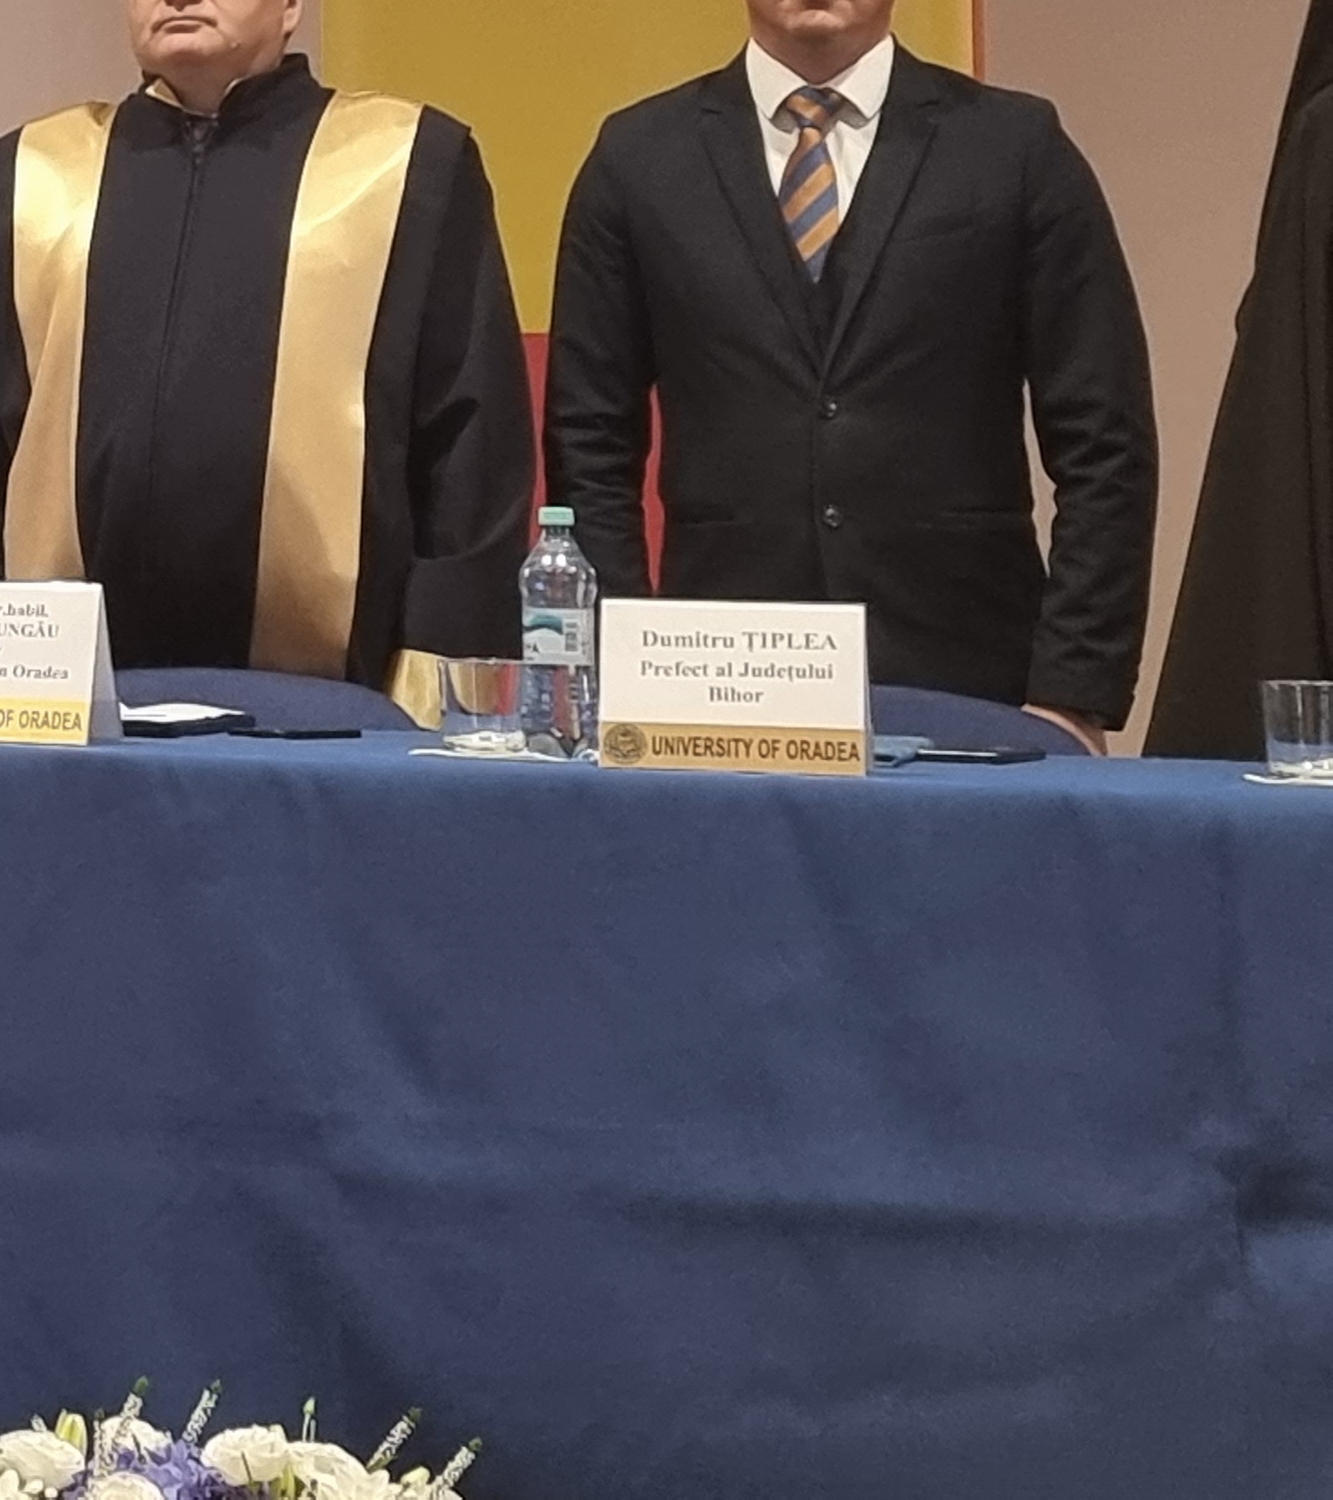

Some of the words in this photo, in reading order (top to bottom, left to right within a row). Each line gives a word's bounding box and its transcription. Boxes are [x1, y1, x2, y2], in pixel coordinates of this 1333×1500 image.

[642, 630, 735, 649] Dumitru
[13, 664, 69, 680] Oradea
[640, 660, 709, 677] Prefect
[715, 661, 732, 677] al
[708, 686, 764, 703] Bihor
[19, 711, 82, 731] ORADEA
[652, 735, 754, 758] UNIVERSITY
[758, 738, 782, 759] OF
[786, 739, 860, 762] ORADEA
